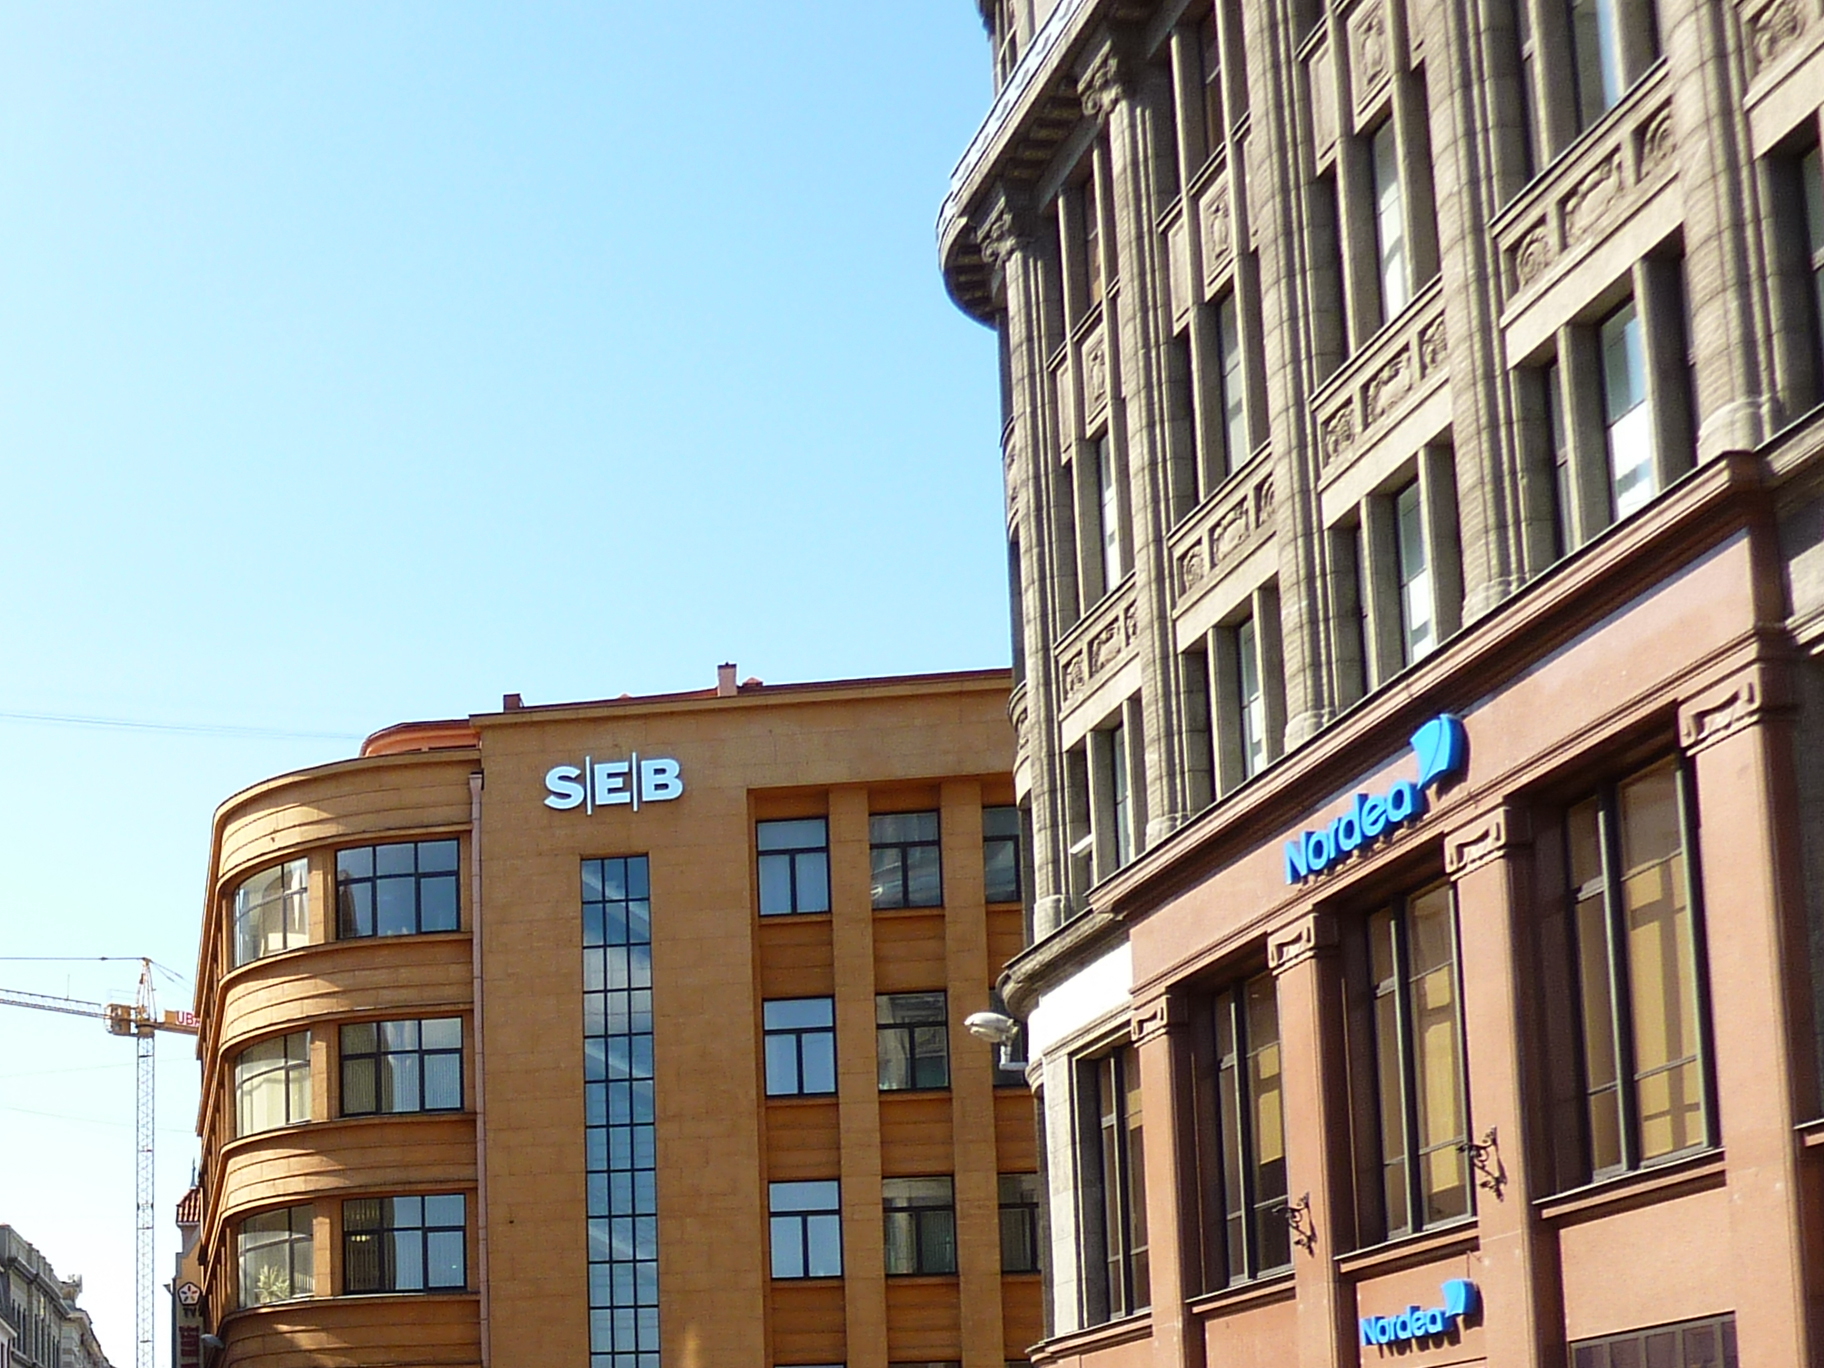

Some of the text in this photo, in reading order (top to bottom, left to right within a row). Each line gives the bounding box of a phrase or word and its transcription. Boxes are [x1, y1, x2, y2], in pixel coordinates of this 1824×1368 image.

[544, 753, 684, 814] SEB
[1284, 779, 1423, 885] Nordea
[1359, 1305, 1448, 1347] Nordea
